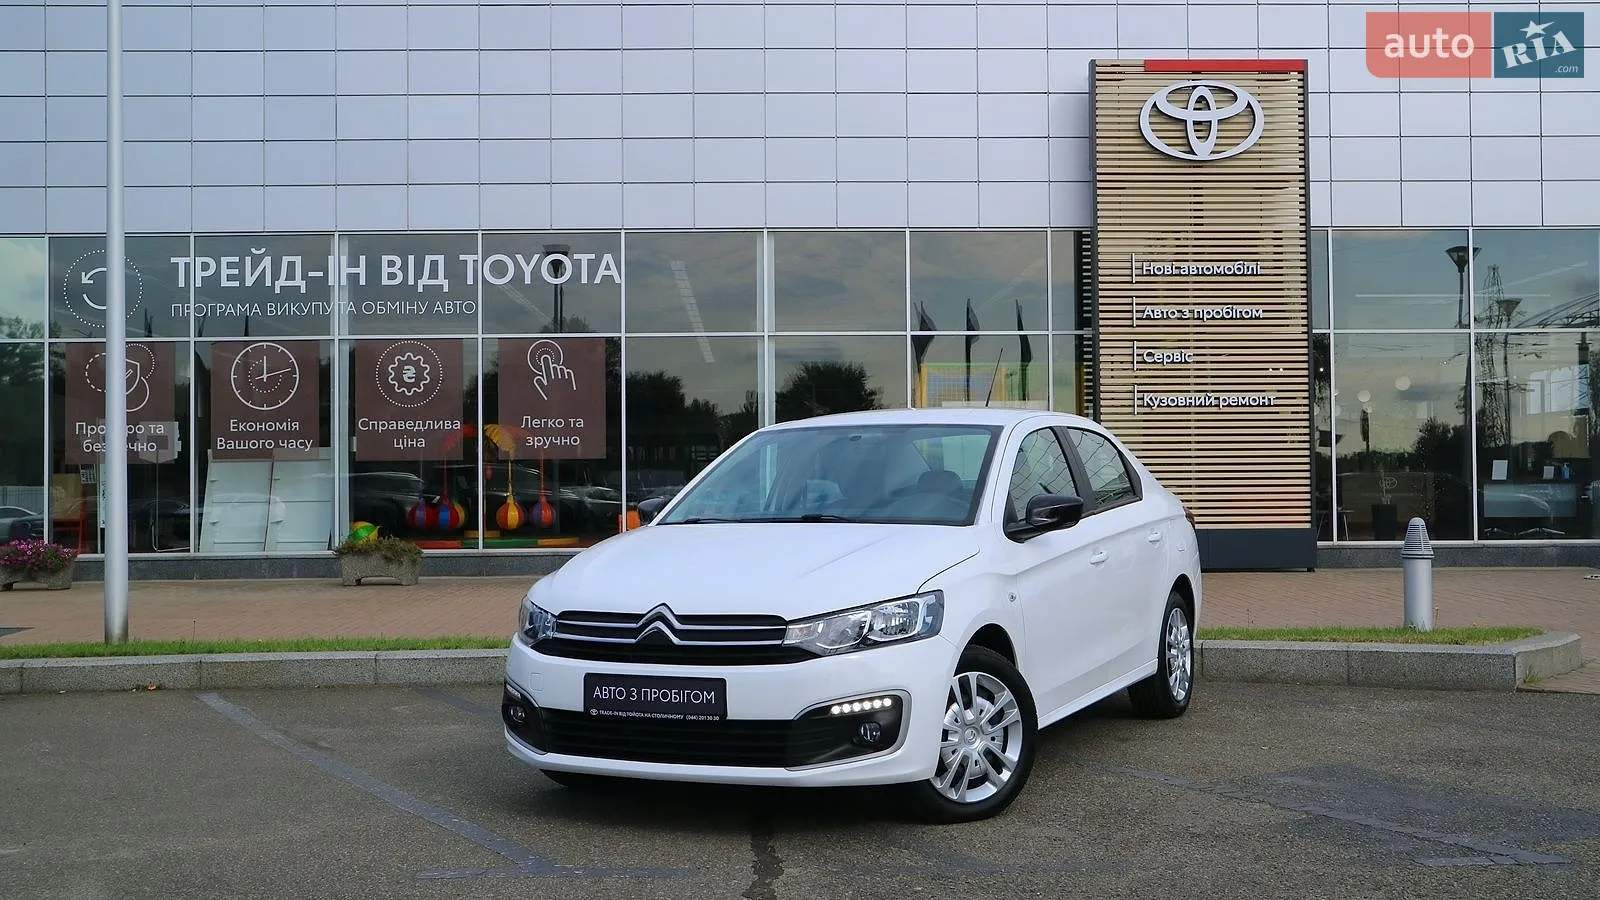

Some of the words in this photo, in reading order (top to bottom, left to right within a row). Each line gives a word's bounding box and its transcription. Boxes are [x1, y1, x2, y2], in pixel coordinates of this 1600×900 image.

[170, 247, 366, 294] ТРЕЙД-ІН
[381, 253, 449, 293] ВІД
[459, 252, 622, 285] TOYOTA
[1142, 261, 1176, 275] Нові
[1180, 260, 1261, 275] автомобілі
[171, 303, 262, 317] ПРОГРАМА
[267, 301, 334, 316] ВИКУПУ
[337, 301, 357, 315] ТА
[362, 301, 429, 315] ОБМІНУ
[433, 300, 476, 314] АВТО
[1142, 305, 1178, 319] Авто
[1181, 308, 1190, 318] з
[1193, 304, 1263, 322] пробігом
[1142, 349, 1194, 366] Сервіс
[1142, 392, 1215, 410] Кузовний
[1219, 395, 1276, 410] ремонт
[229, 418, 300, 432] Економія
[358, 417, 461, 433] Справедлива
[520, 415, 565, 428] Легко
[568, 418, 584, 428] та
[75, 422, 145, 437] Проро
[148, 424, 164, 434] та
[216, 437, 274, 450] Вашого
[278, 438, 313, 452] часу
[393, 435, 426, 449] ціна
[525, 436, 581, 449] зручно
[592, 685, 627, 700] АВТО
[629, 687, 638, 701] З
[641, 688, 715, 704] ПРОБІГОМ
